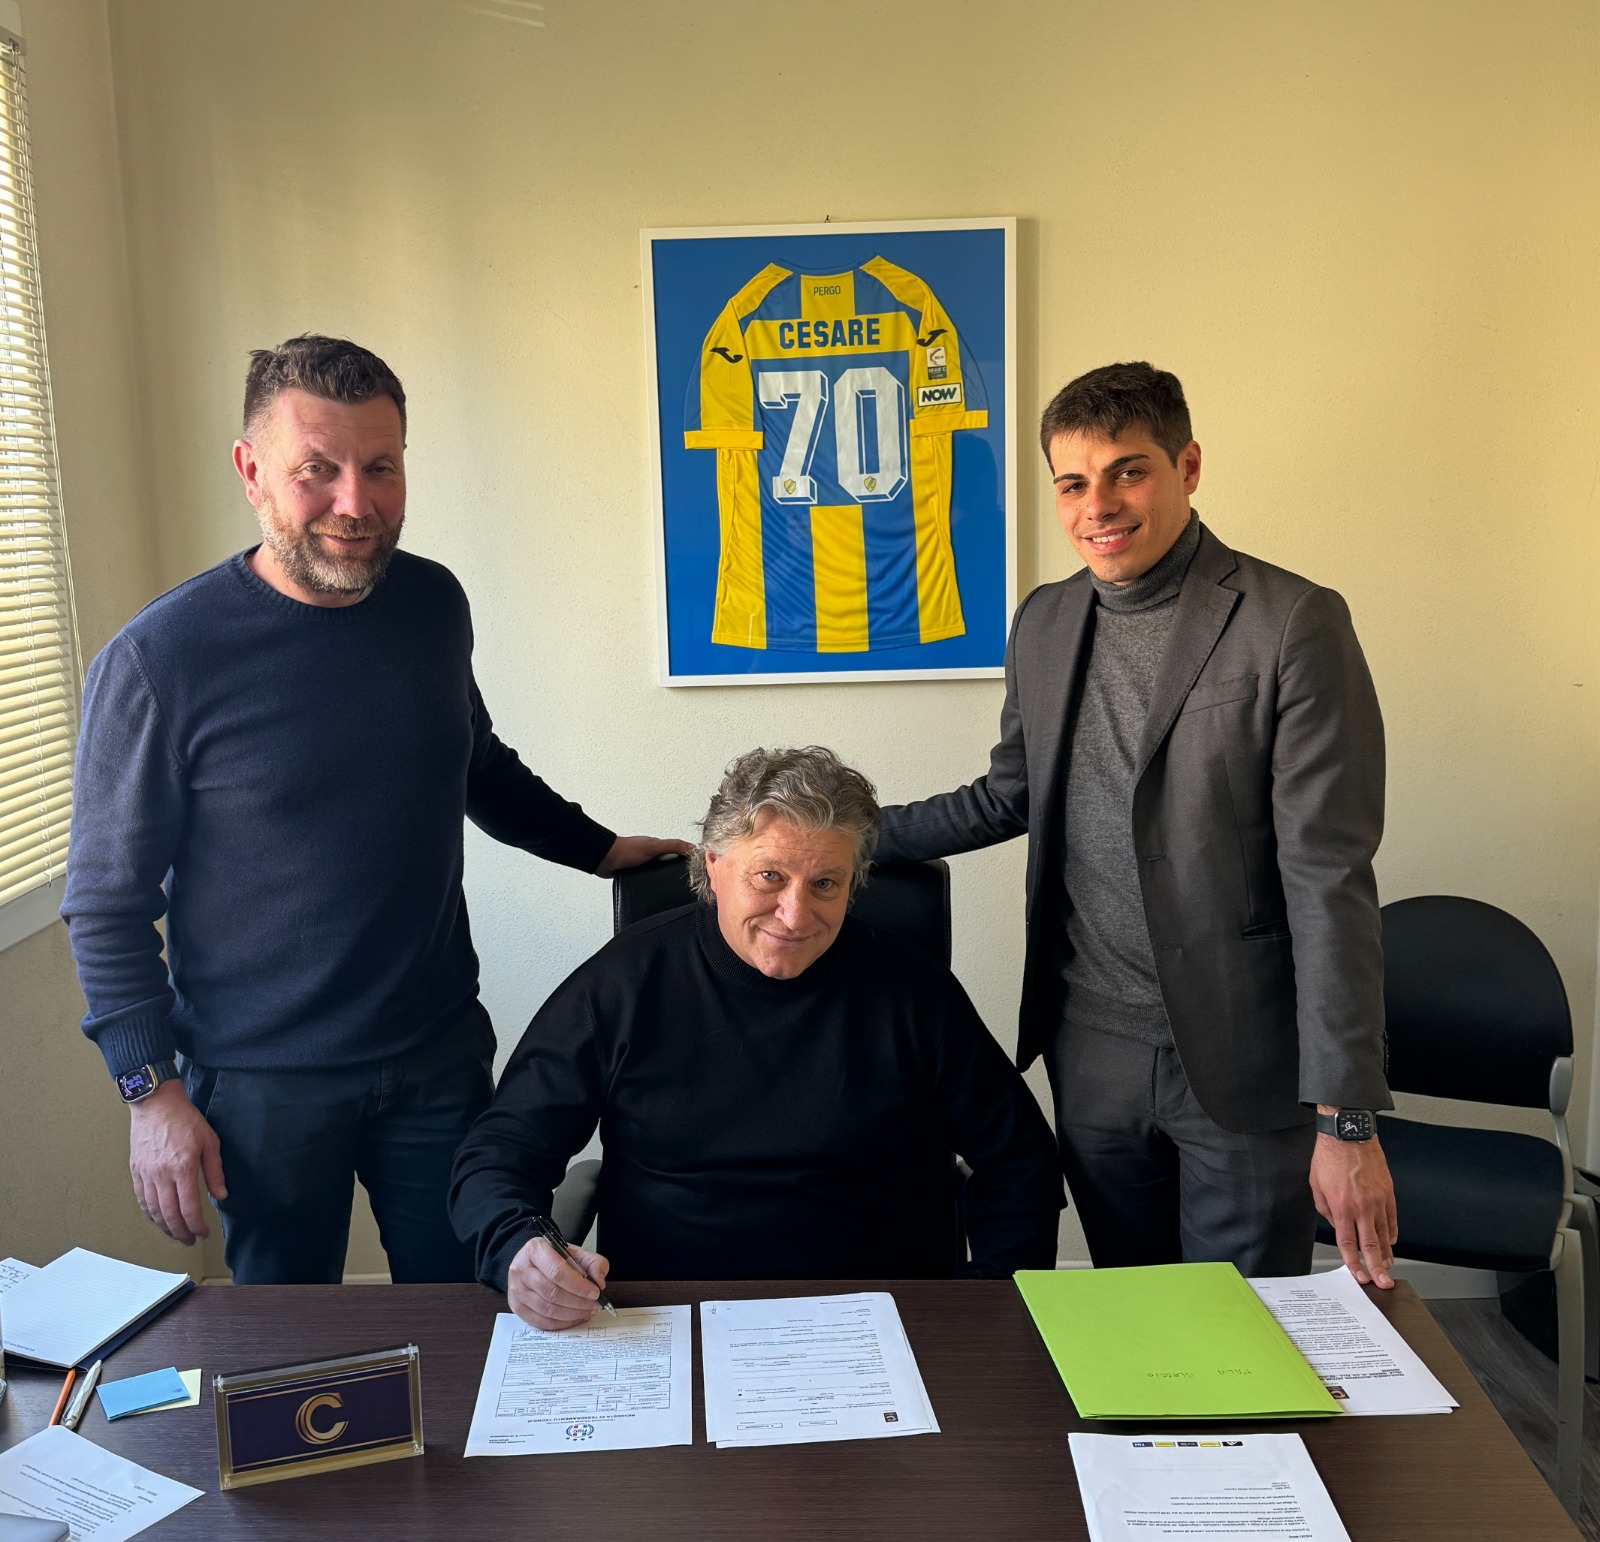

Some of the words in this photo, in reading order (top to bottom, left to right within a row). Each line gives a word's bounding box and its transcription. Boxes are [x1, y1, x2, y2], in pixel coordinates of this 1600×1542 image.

[813, 286, 841, 296] PERGO
[779, 318, 880, 349] CESARE
[922, 387, 957, 402] NOW
[758, 367, 909, 505] 70
[295, 1392, 349, 1445] C
